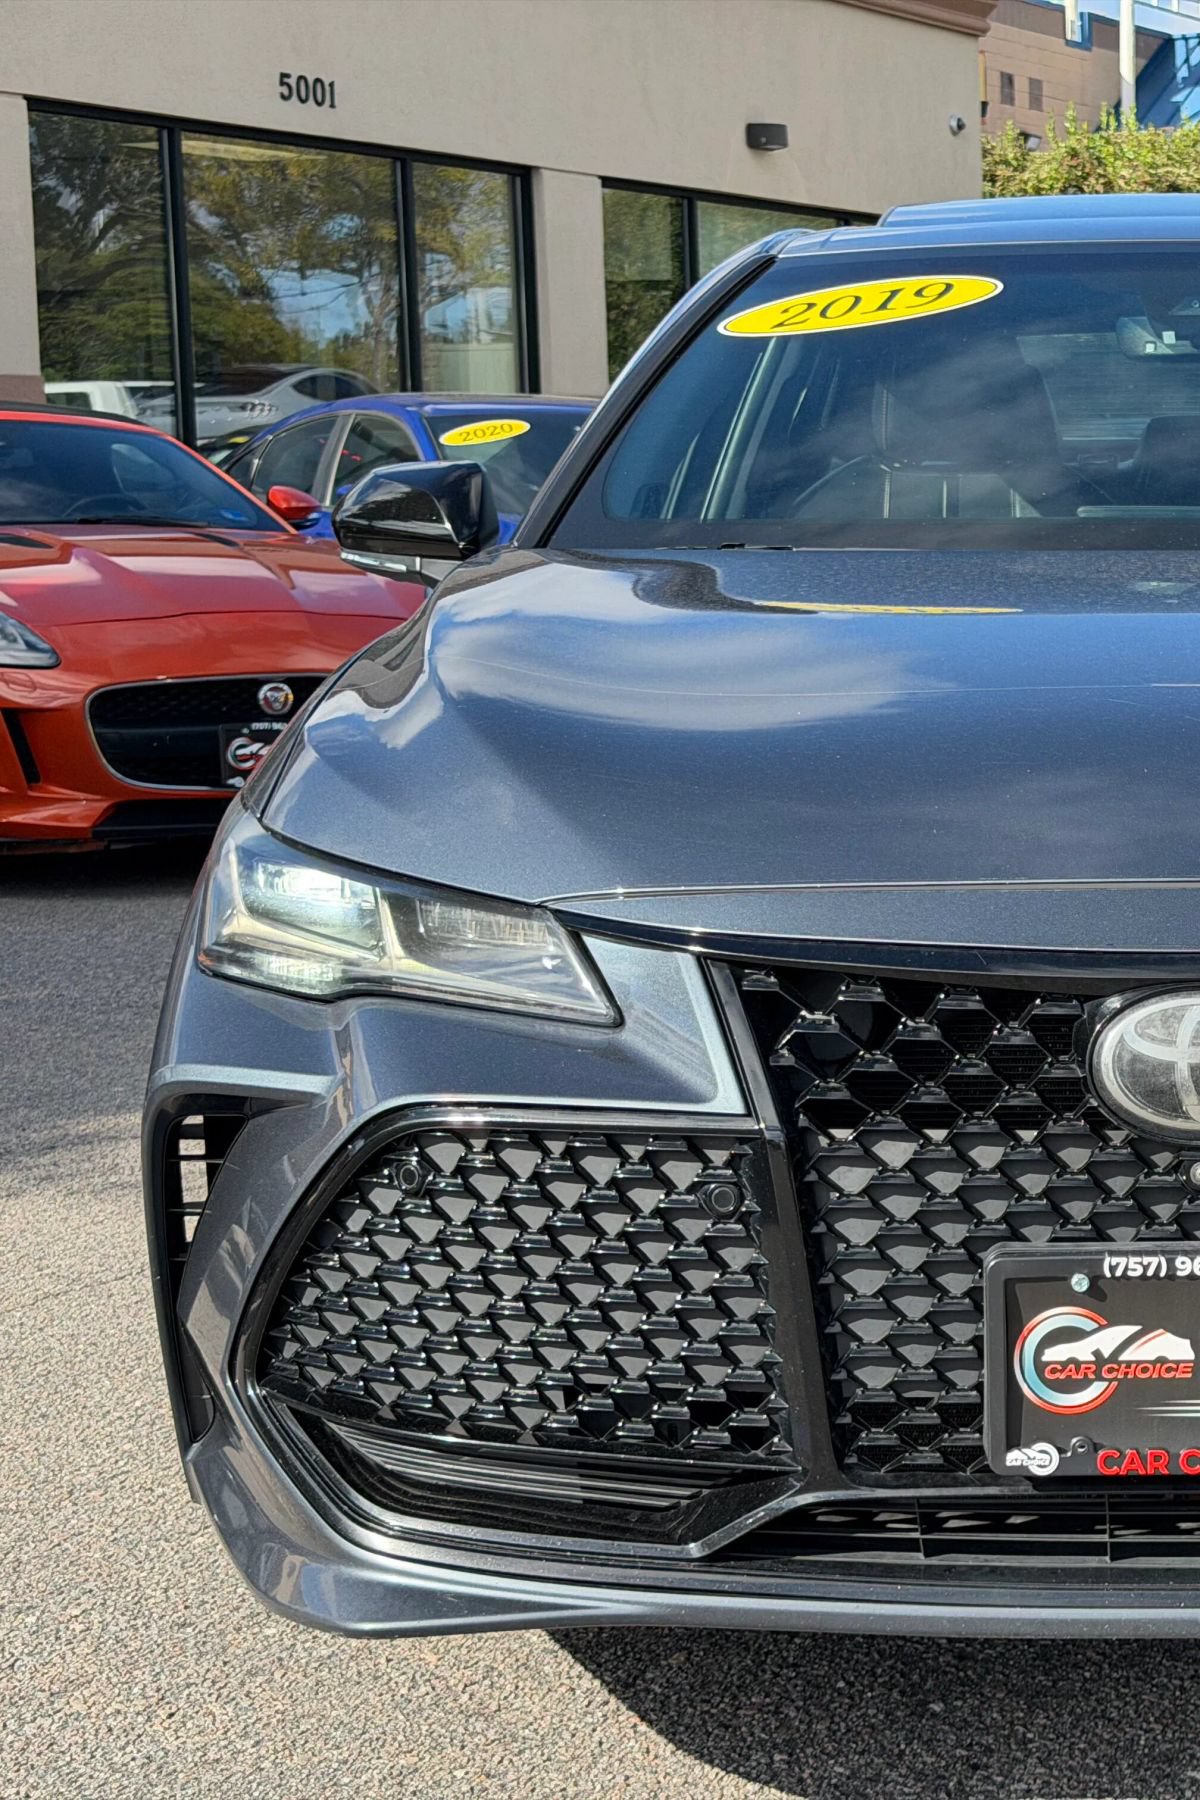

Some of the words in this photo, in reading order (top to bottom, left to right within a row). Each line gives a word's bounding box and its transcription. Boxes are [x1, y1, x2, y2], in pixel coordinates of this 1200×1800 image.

[279, 72, 336, 109] 5001
[770, 282, 955, 329] 2019
[460, 423, 513, 442] 2020
[1103, 1254, 1167, 1278] (757)
[1044, 1363, 1096, 1379] CAR
[1101, 1362, 1194, 1379] CHOICE
[1097, 1449, 1169, 1475] CAR
